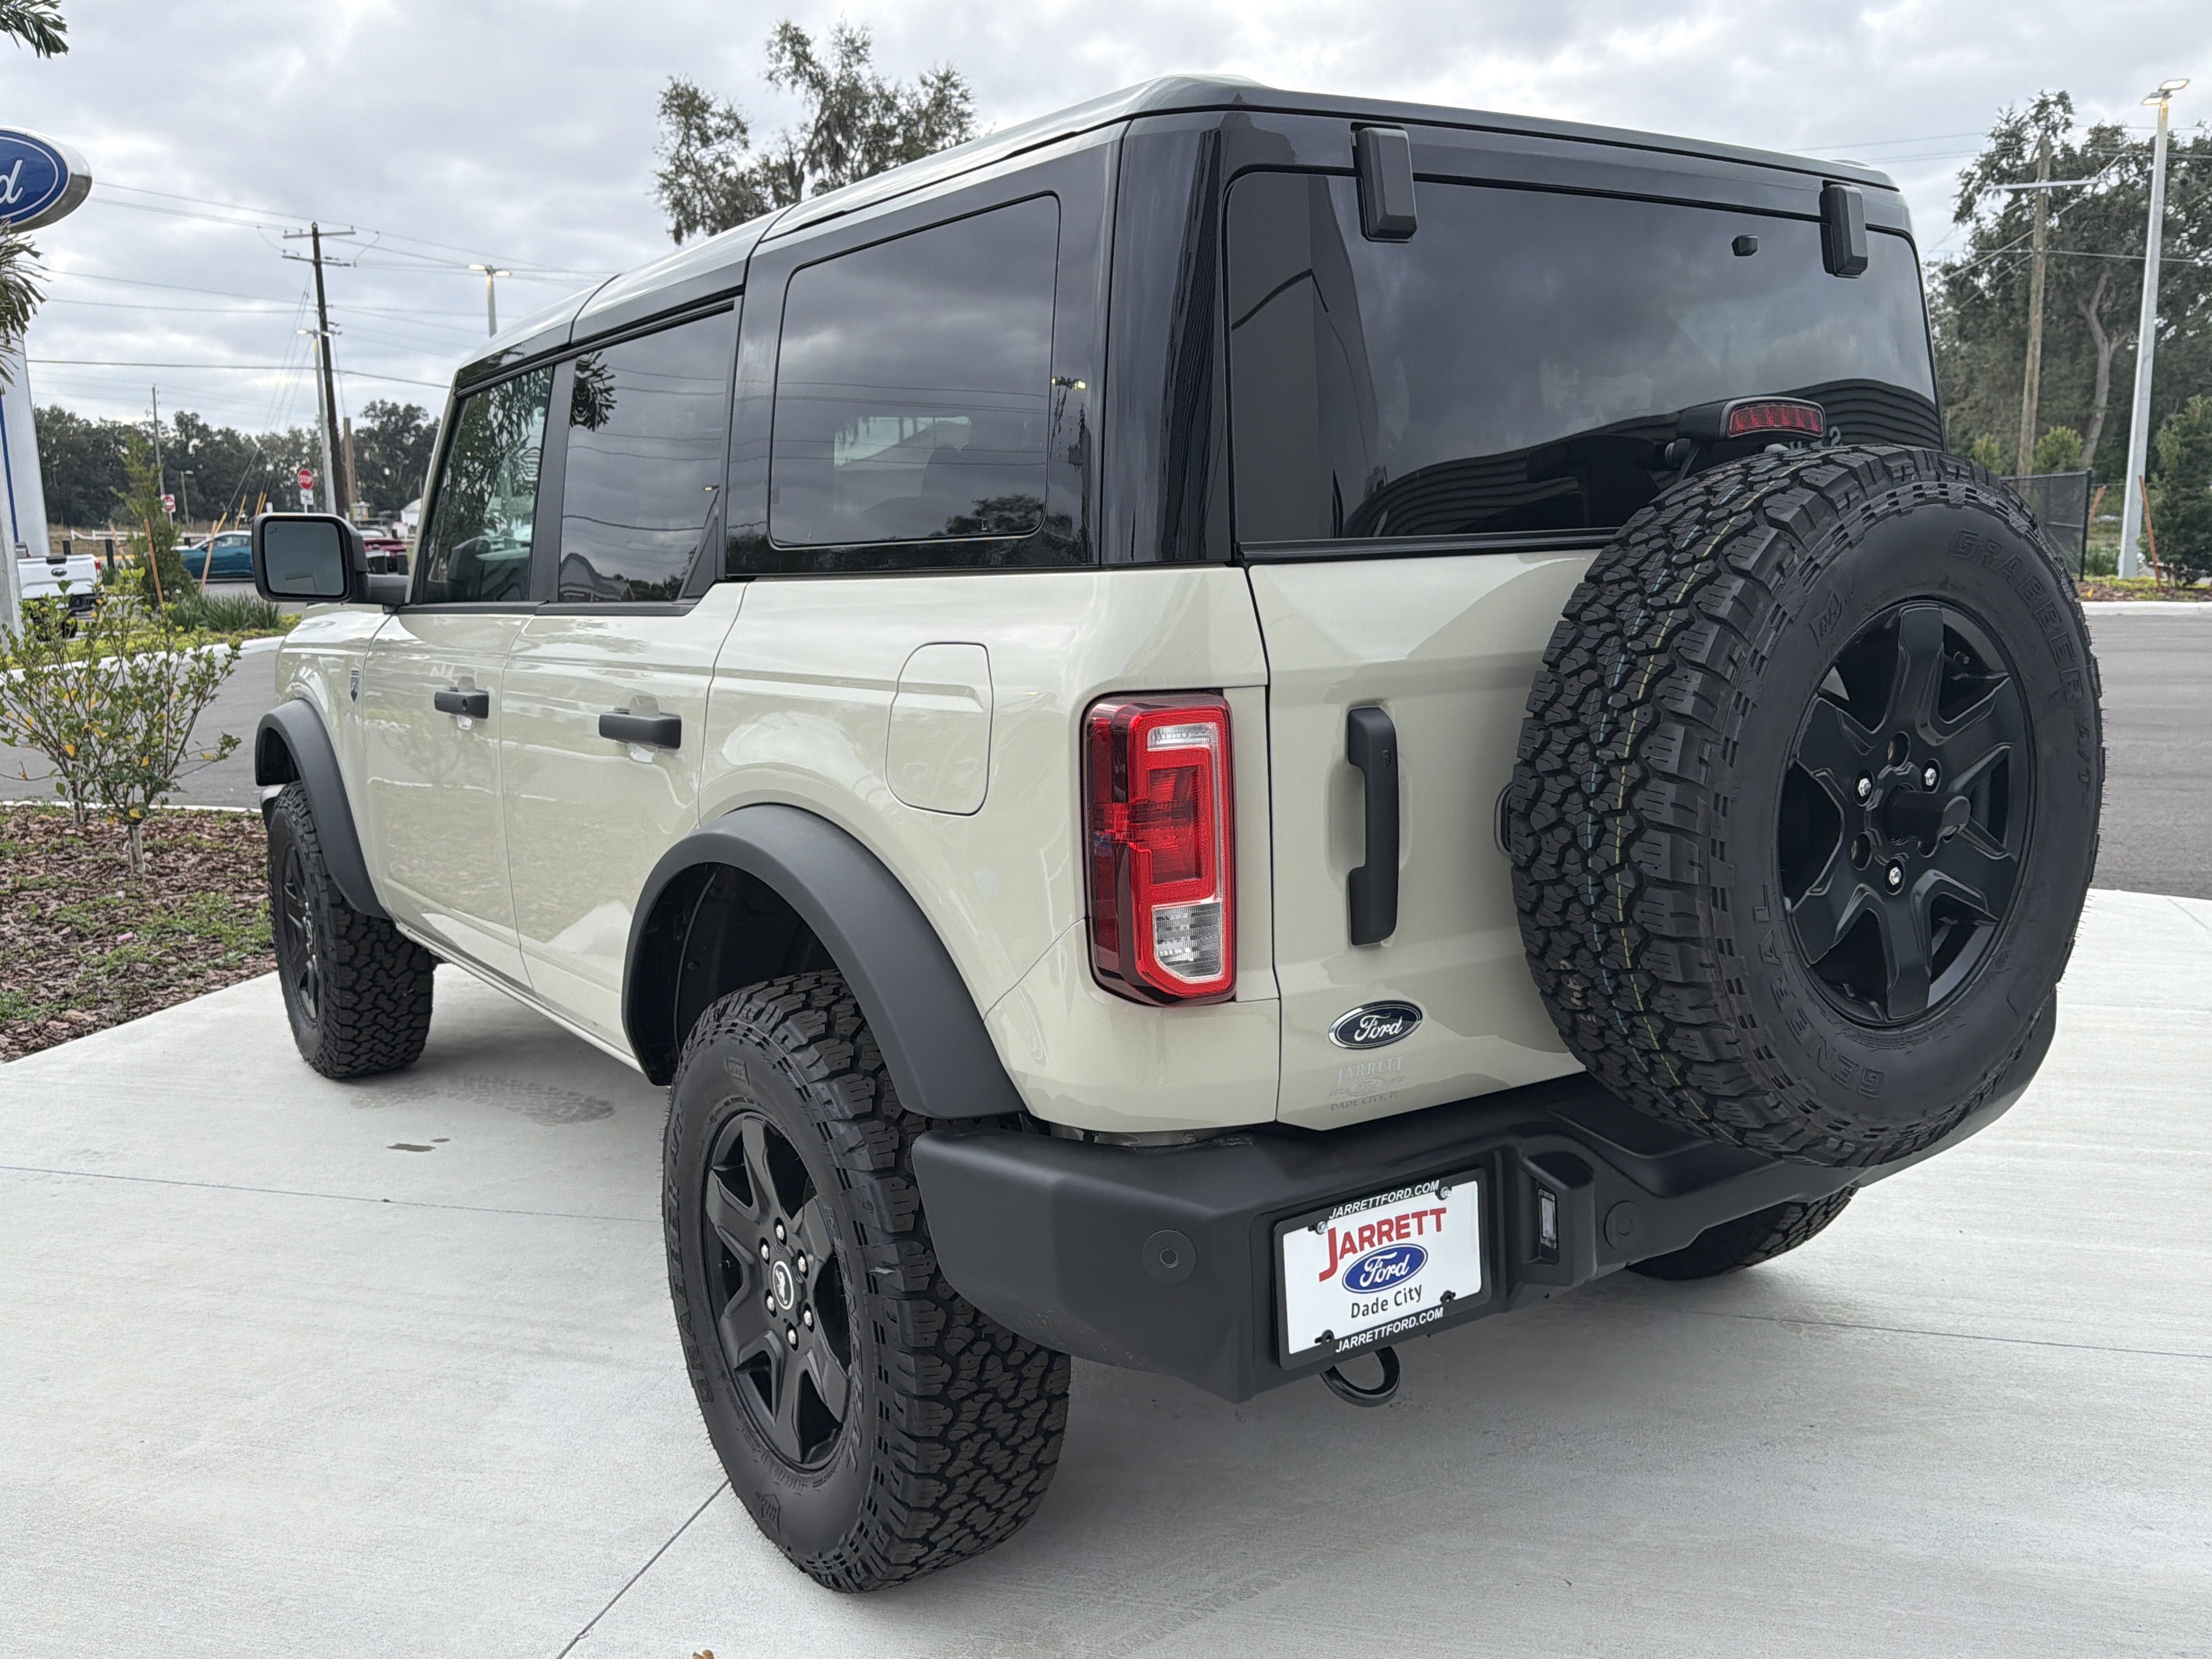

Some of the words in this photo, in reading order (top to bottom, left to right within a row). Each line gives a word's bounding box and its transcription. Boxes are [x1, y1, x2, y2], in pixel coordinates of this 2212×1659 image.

[300, 474, 312, 484] STOP
[1949, 528, 2084, 700] GRABBER
[1753, 883, 1885, 1098] GENERAL
[1353, 1011, 1403, 1042] Ford
[1332, 1056, 1405, 1086] JARRETT
[1328, 1180, 1440, 1220] JARRETTFORD.COM
[1319, 1206, 1447, 1283] JARRETT
[1359, 1251, 1410, 1287] Ford
[668, 1176, 713, 1403] GRABBER
[1350, 1296, 1389, 1319] Dade
[1393, 1284, 1423, 1307] City
[1335, 1306, 1444, 1353] JARRETTFORD.COM
